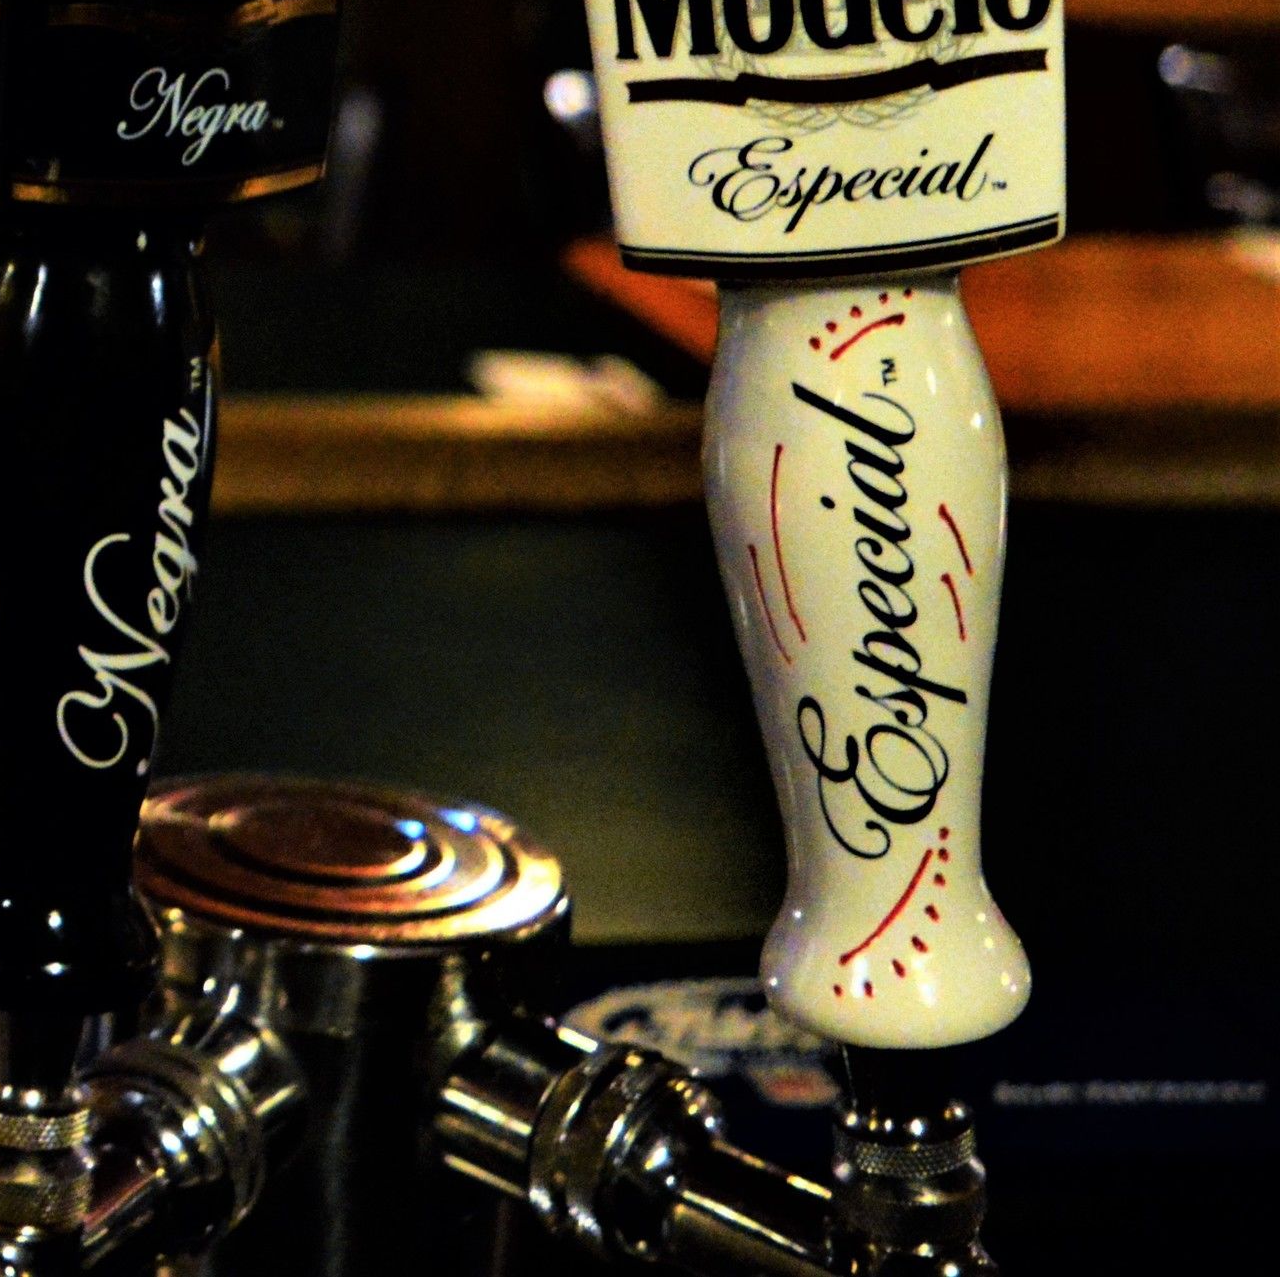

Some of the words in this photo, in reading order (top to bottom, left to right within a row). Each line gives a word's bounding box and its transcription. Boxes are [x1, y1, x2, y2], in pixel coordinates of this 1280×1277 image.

[116, 67, 269, 166] Negra
[688, 132, 990, 235] Especial
[56, 407, 200, 777] Negra
[791, 380, 968, 861] Especial
